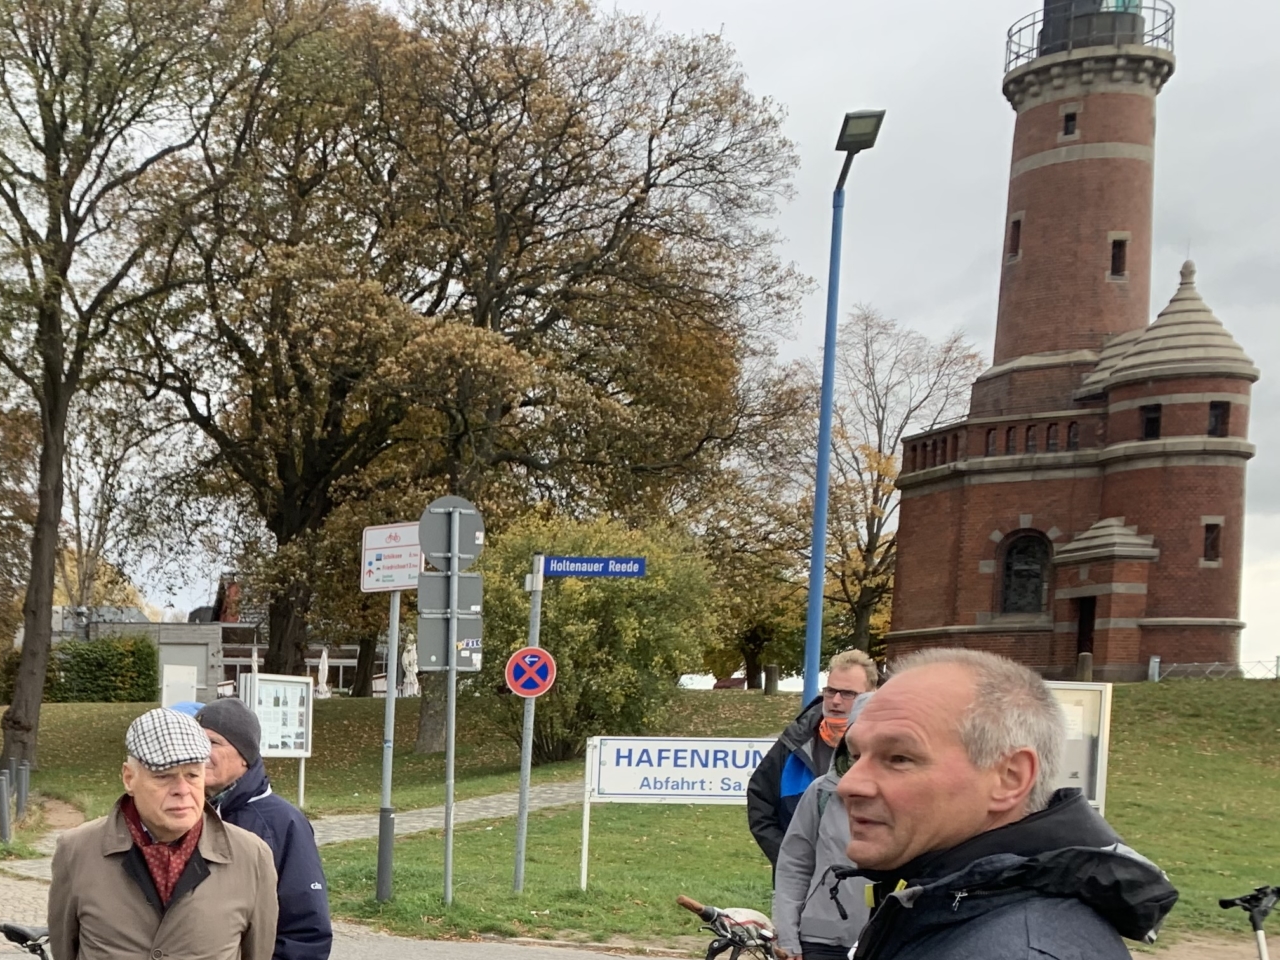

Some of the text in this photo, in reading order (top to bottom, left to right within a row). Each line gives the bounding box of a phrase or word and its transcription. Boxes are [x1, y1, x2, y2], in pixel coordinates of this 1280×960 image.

[550, 559, 640, 573] Holtenauer Reede
[720, 777, 746, 792] Sa.
